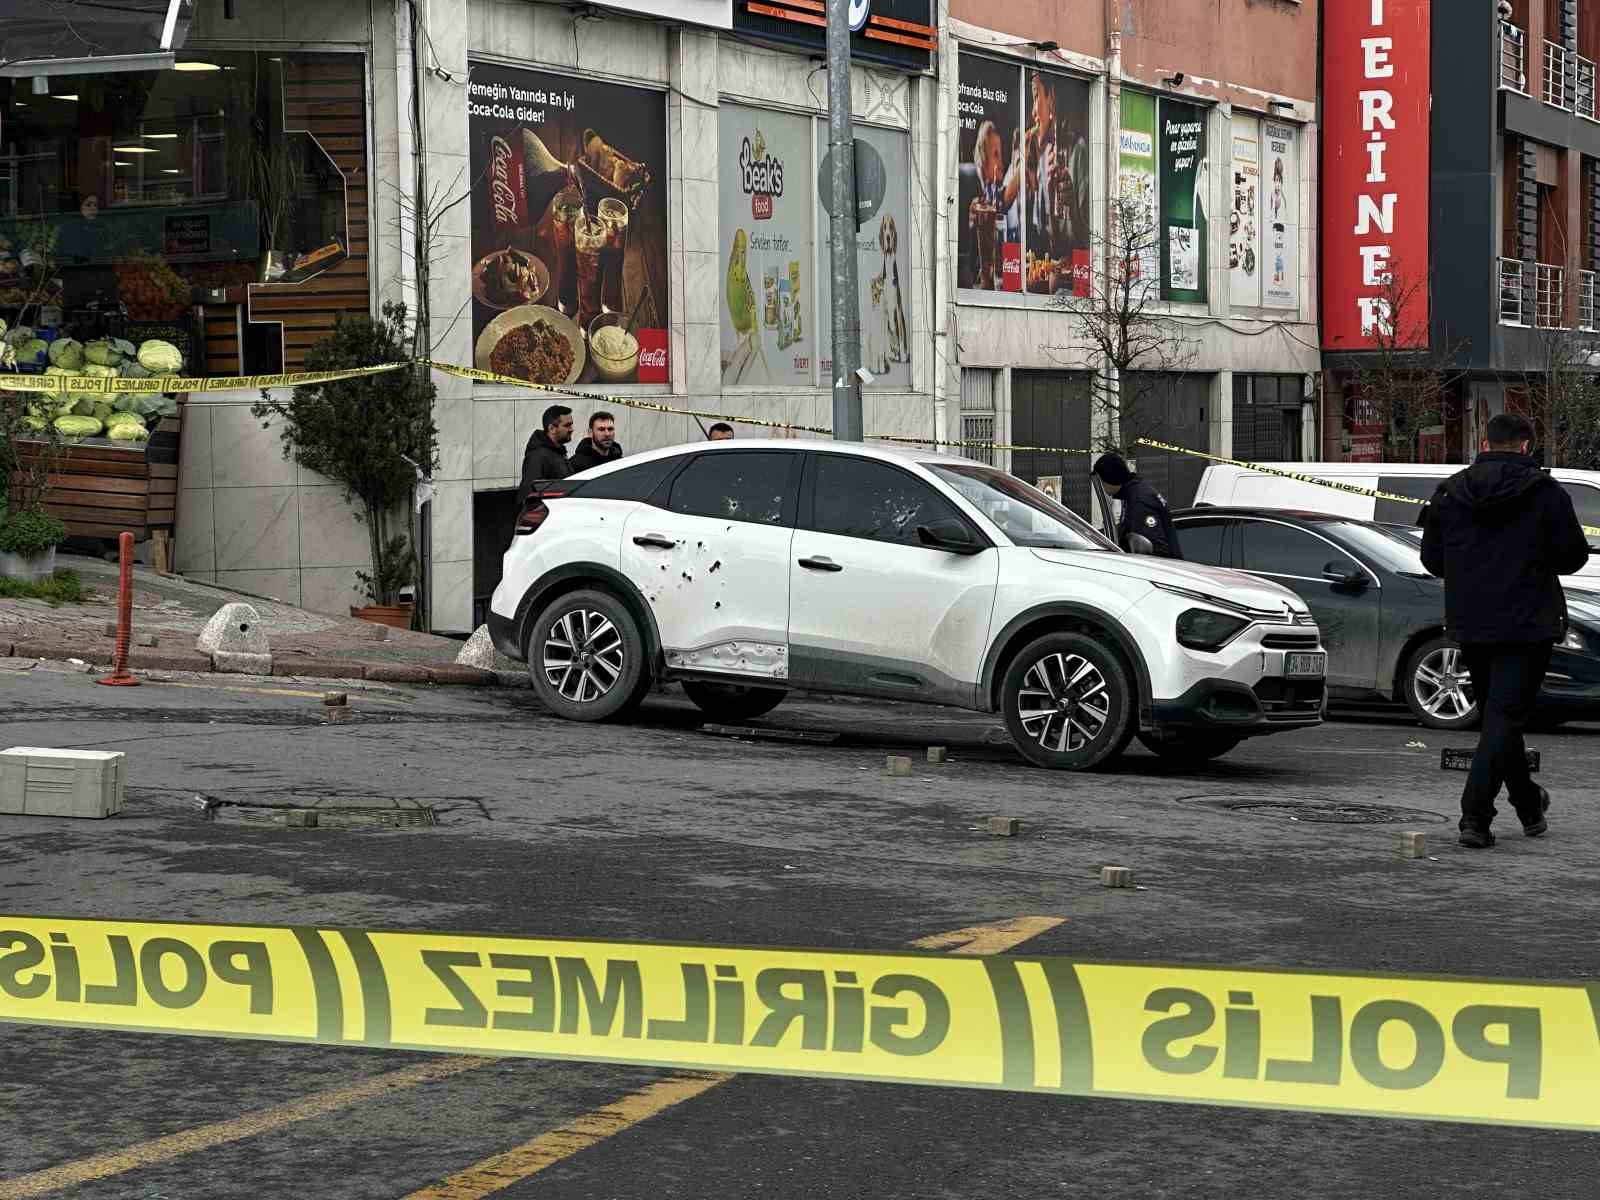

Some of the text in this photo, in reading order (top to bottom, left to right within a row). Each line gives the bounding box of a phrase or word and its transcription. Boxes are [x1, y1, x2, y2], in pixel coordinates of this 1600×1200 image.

[467, 81, 575, 111] Yemeğin Yanında En İyi
[982, 87, 995, 101] Buz
[995, 90, 1008, 103] Gibi
[516, 106, 545, 123] Gider!
[755, 199, 769, 213] food
